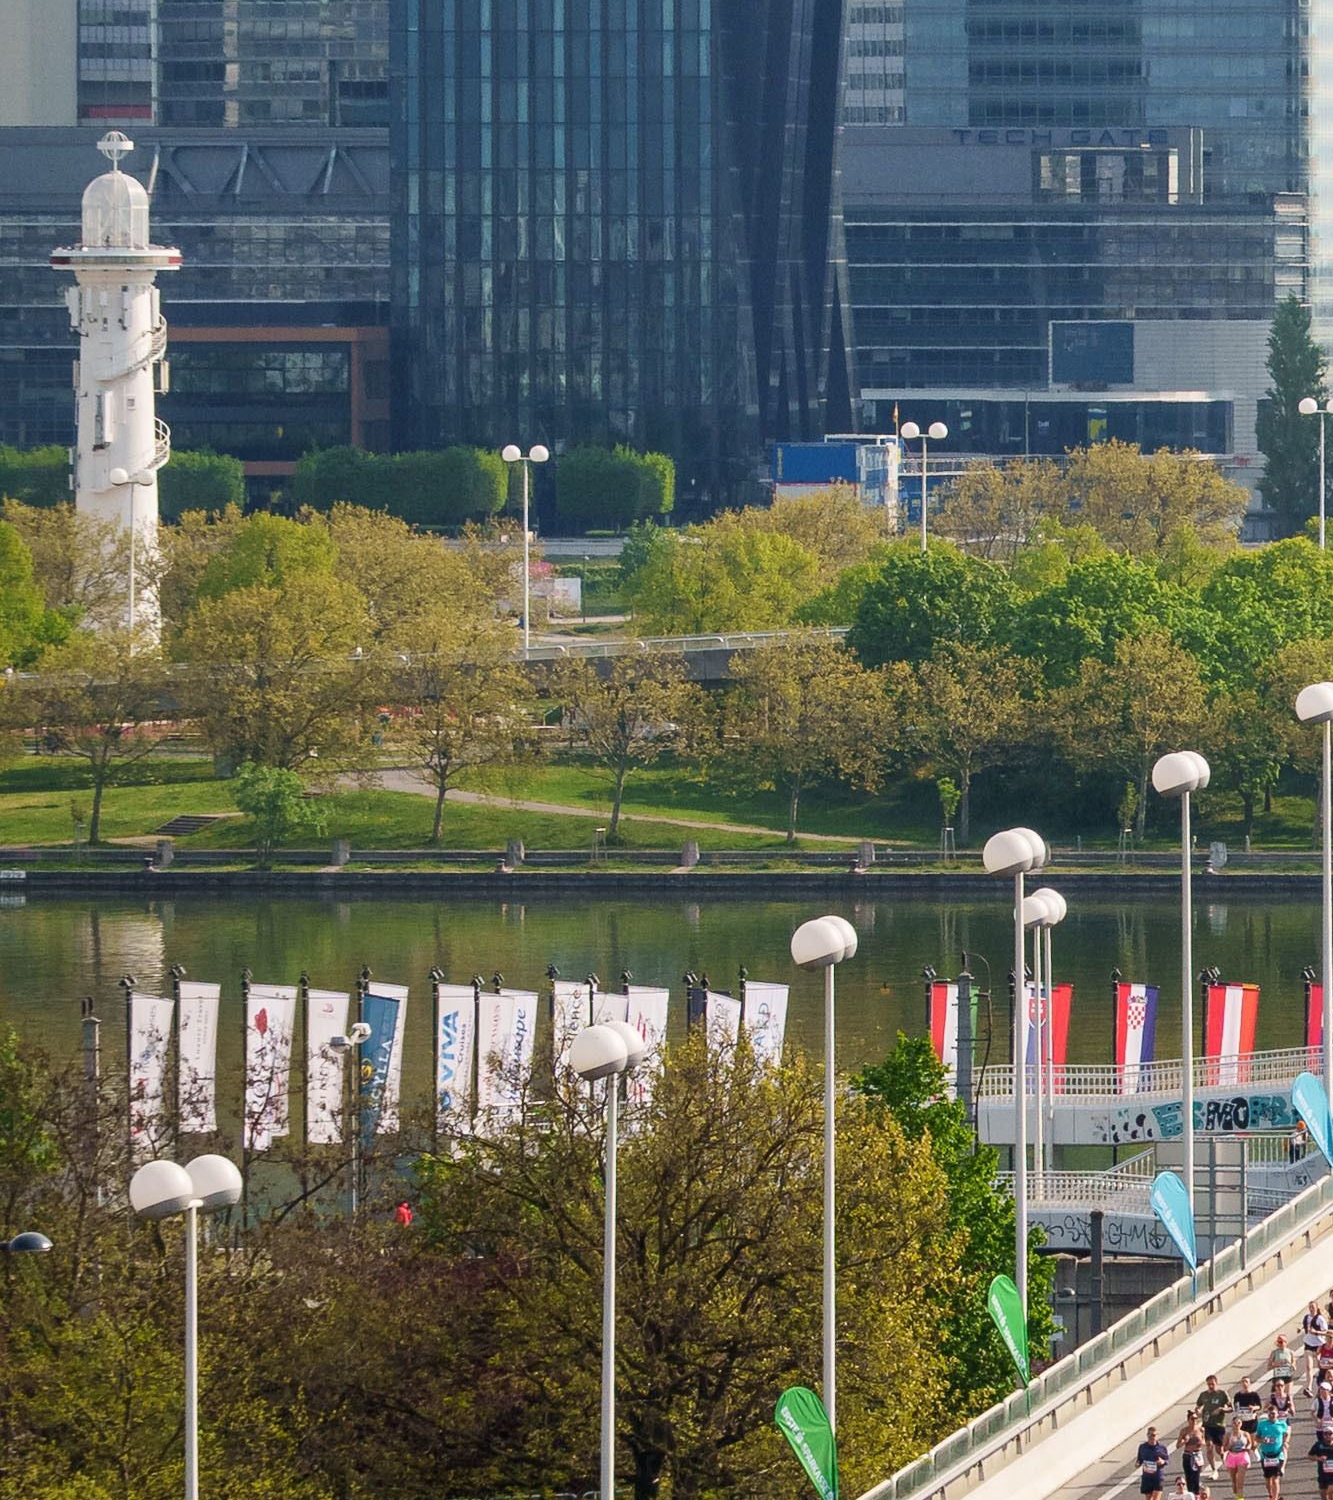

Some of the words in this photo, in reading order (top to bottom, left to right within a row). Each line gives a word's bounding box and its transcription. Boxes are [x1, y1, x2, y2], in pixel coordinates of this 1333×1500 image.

[952, 129, 1051, 146] TECH
[1071, 129, 1169, 145] GATE
[440, 1010, 459, 1081] VIVA
[457, 1023, 467, 1063] Cruises
[801, 1443, 829, 1493] SPARKASSE
